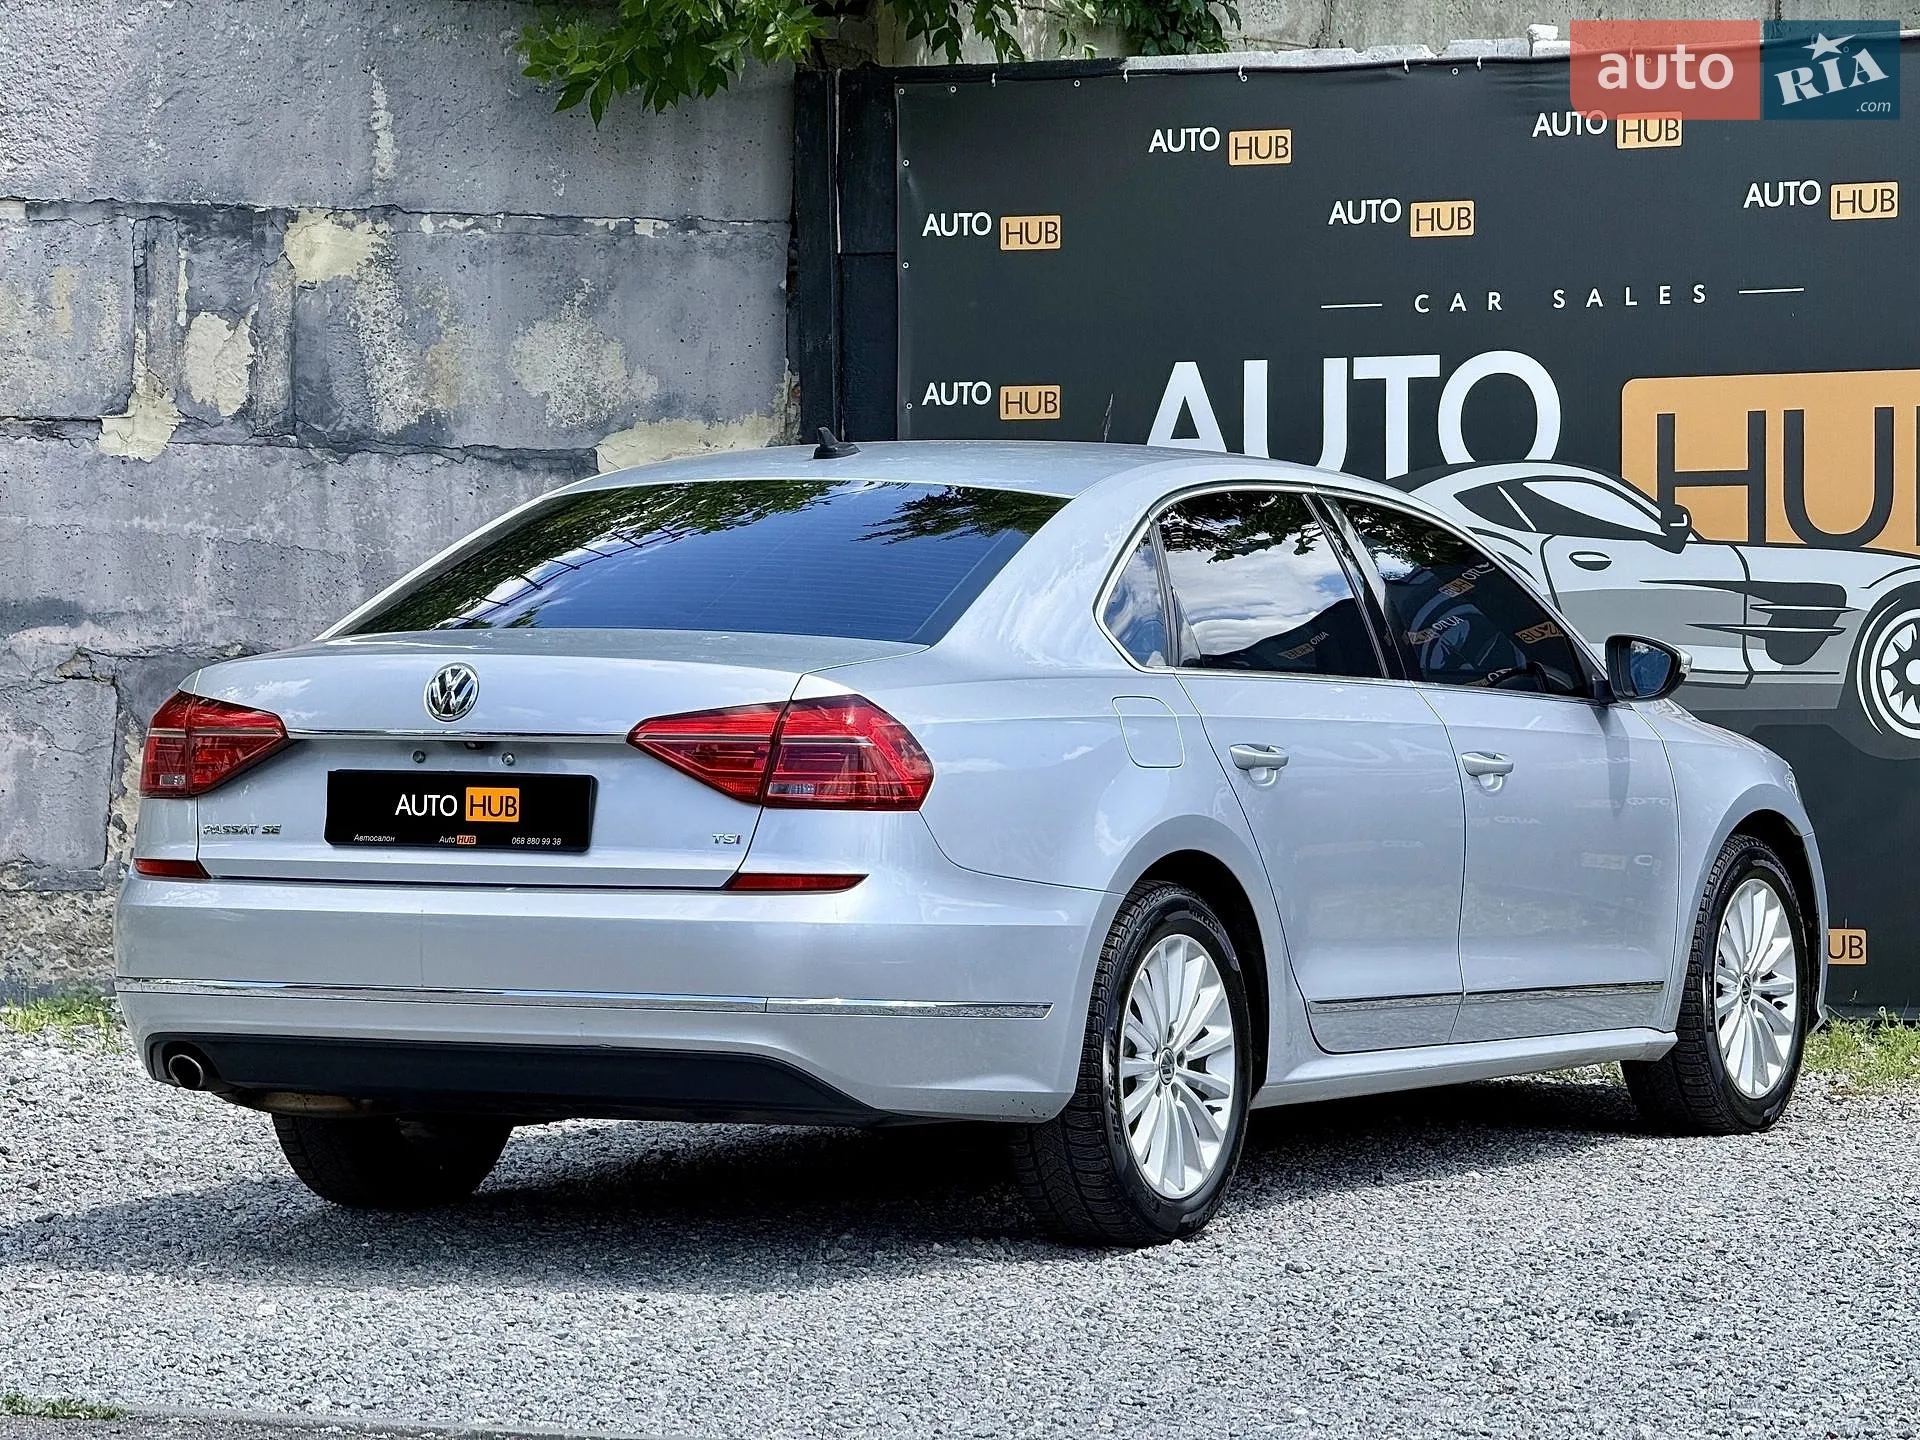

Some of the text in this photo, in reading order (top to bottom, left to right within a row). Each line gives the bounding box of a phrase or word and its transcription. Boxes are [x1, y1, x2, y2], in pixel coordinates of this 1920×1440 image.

[1532, 110, 1680, 144] AUTO HUB
[1149, 127, 1289, 160] AUTO HUB
[1744, 180, 1896, 215] AUTO HUB
[922, 212, 1059, 245] AUTO HUB
[1329, 199, 1472, 231] AUTO HUB
[1414, 284, 1706, 312] CAR SALES
[922, 381, 1058, 414] AUTO HUB
[1147, 351, 1920, 548] AUTO HU
[395, 794, 518, 817] AUTO HUB
[203, 824, 281, 835] PASSAT SE
[353, 833, 395, 843] Автосалон
[439, 836, 455, 844] Auto
[512, 836, 525, 845] 068
[541, 837, 551, 846] 99
[552, 838, 562, 846] 38
[712, 833, 741, 845] TSI
[1828, 935, 1864, 959] UB
